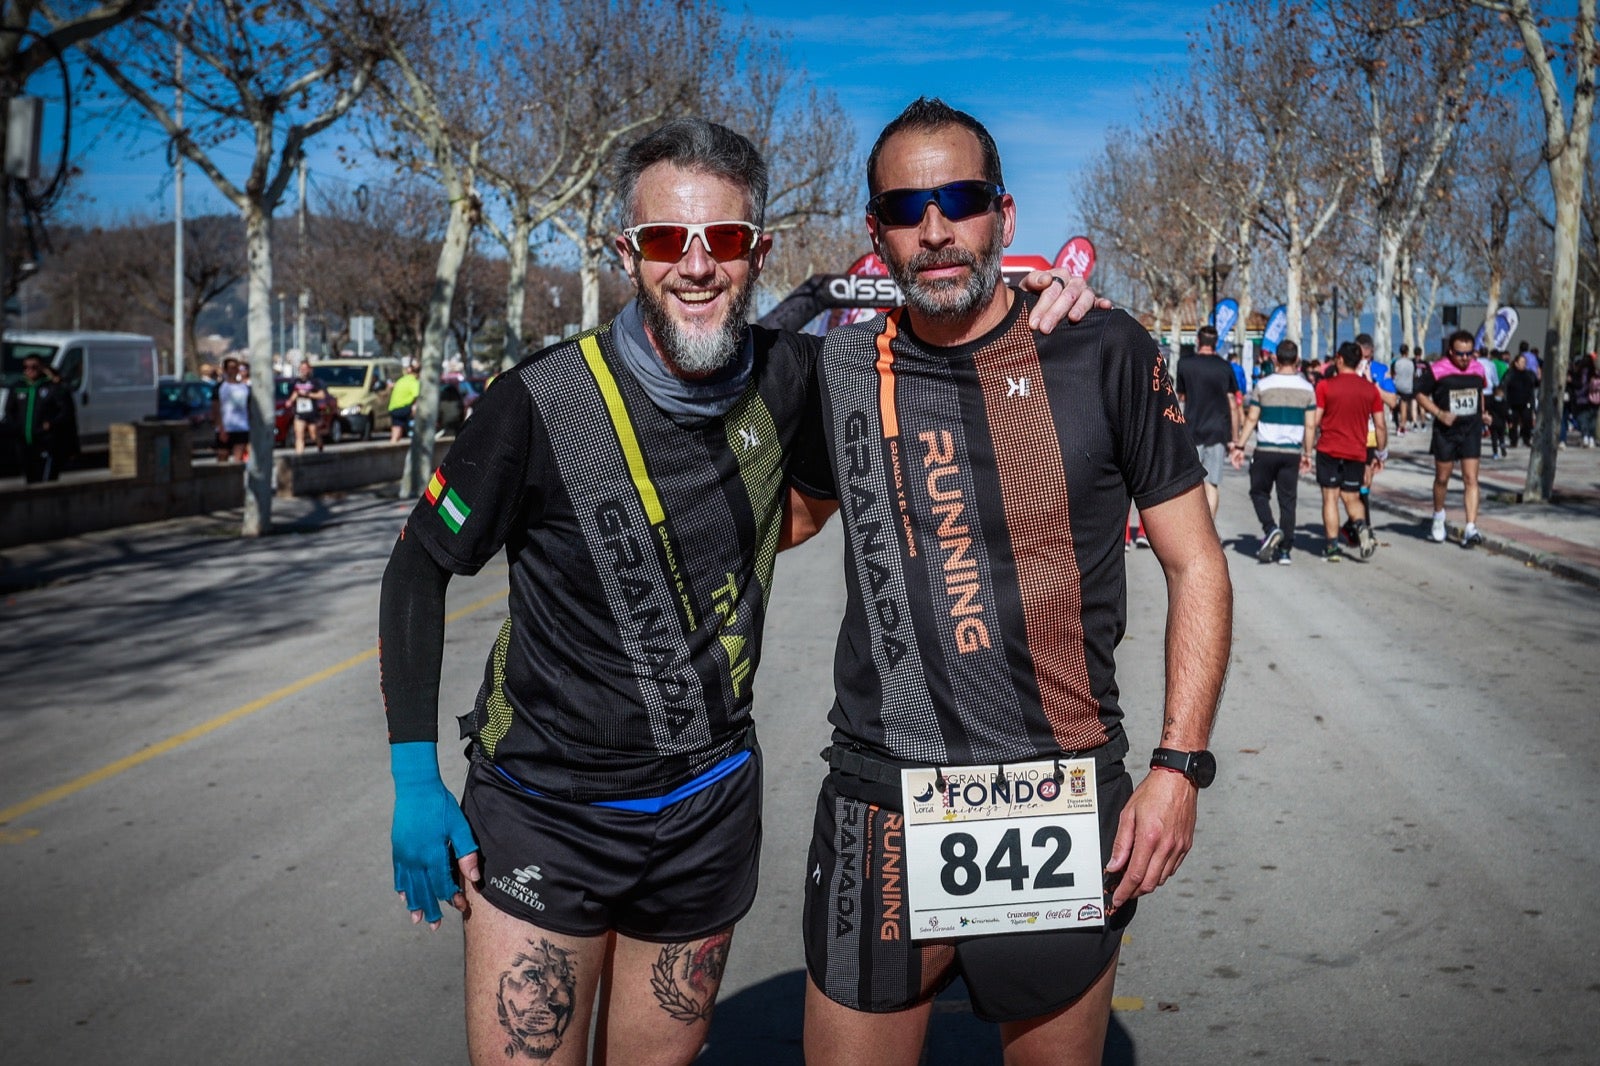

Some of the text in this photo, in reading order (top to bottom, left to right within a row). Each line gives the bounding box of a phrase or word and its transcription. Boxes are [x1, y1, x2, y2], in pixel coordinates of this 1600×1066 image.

[1455, 397, 1474, 409] 343
[845, 410, 908, 671] GRANADA
[890, 441, 917, 557] GRANADA X EL RUNNING
[918, 430, 990, 655] RUNNING
[595, 500, 697, 740] GRANADA
[658, 526, 697, 632] GRANADA X EL RUNNING
[712, 573, 750, 698] TRAIL
[947, 773, 986, 785] GRAN
[990, 769, 1039, 785] PEMIO
[948, 777, 1061, 808] FONDO
[1042, 784, 1056, 795] 24
[489, 876, 546, 912] POLISALUD
[836, 799, 859, 938] RANADA
[880, 813, 904, 941] RUNNING
[940, 826, 1075, 896] 842
[1006, 911, 1040, 919] Cruzcampo
